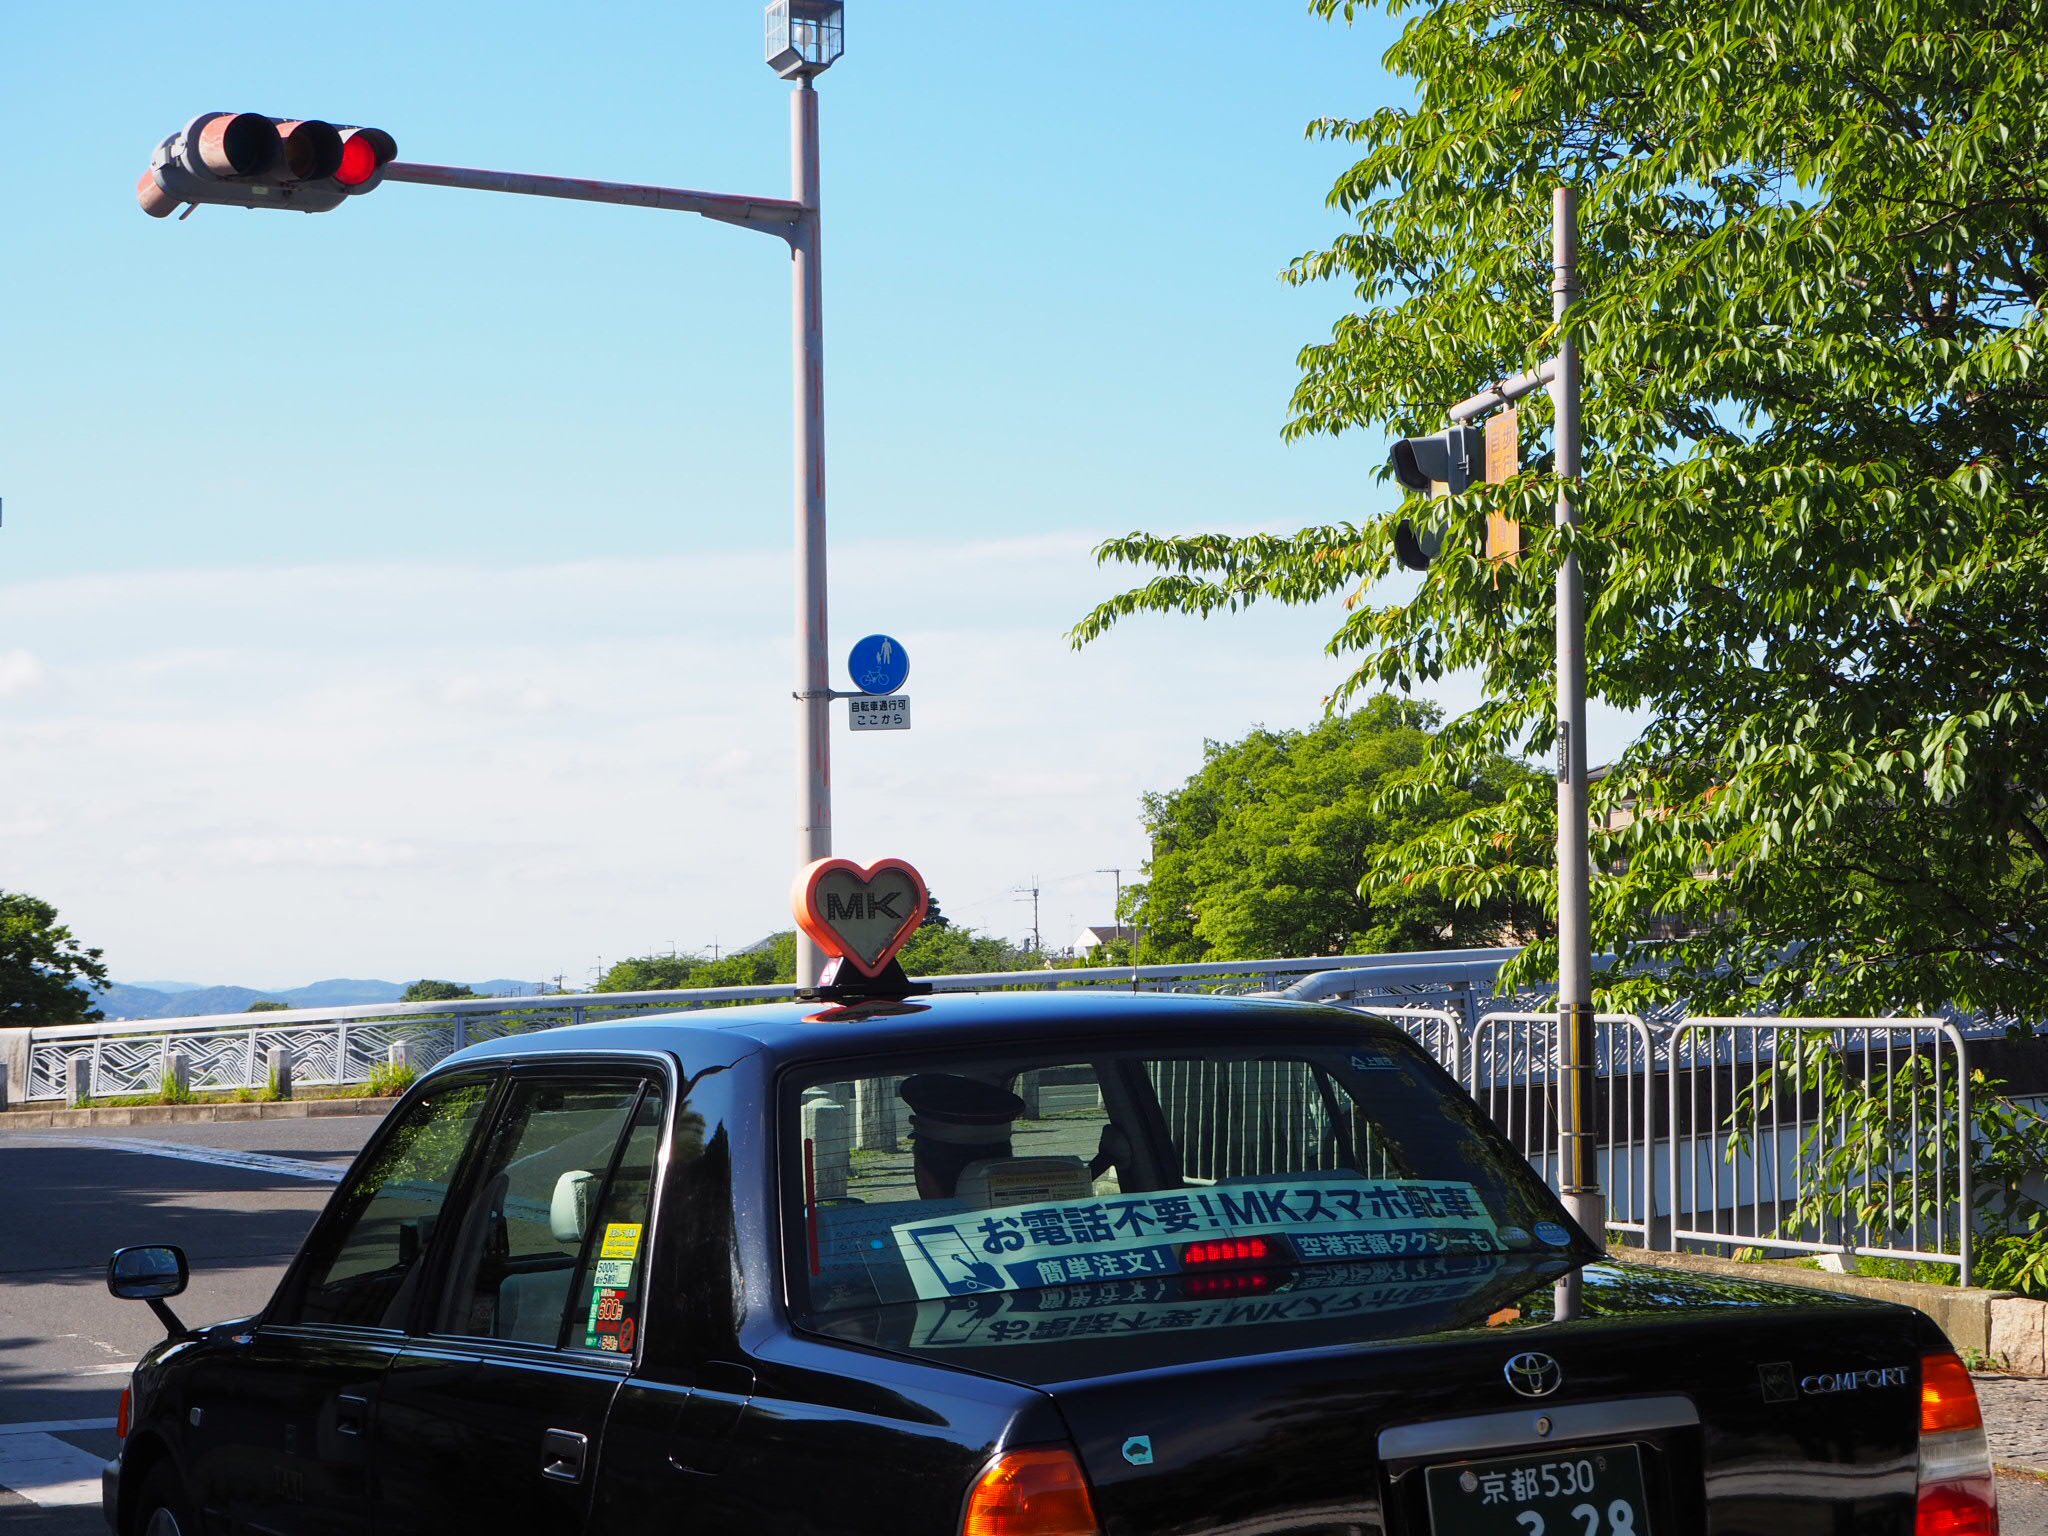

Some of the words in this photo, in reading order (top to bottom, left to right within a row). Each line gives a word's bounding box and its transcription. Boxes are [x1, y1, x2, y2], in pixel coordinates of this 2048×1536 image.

[851, 699, 906, 713] 自転車通行可
[857, 713, 903, 726] ここから
[826, 891, 904, 920] MK
[1036, 1249, 1166, 1286] 簡単注文!
[1800, 1366, 1909, 1394] COMFORT
